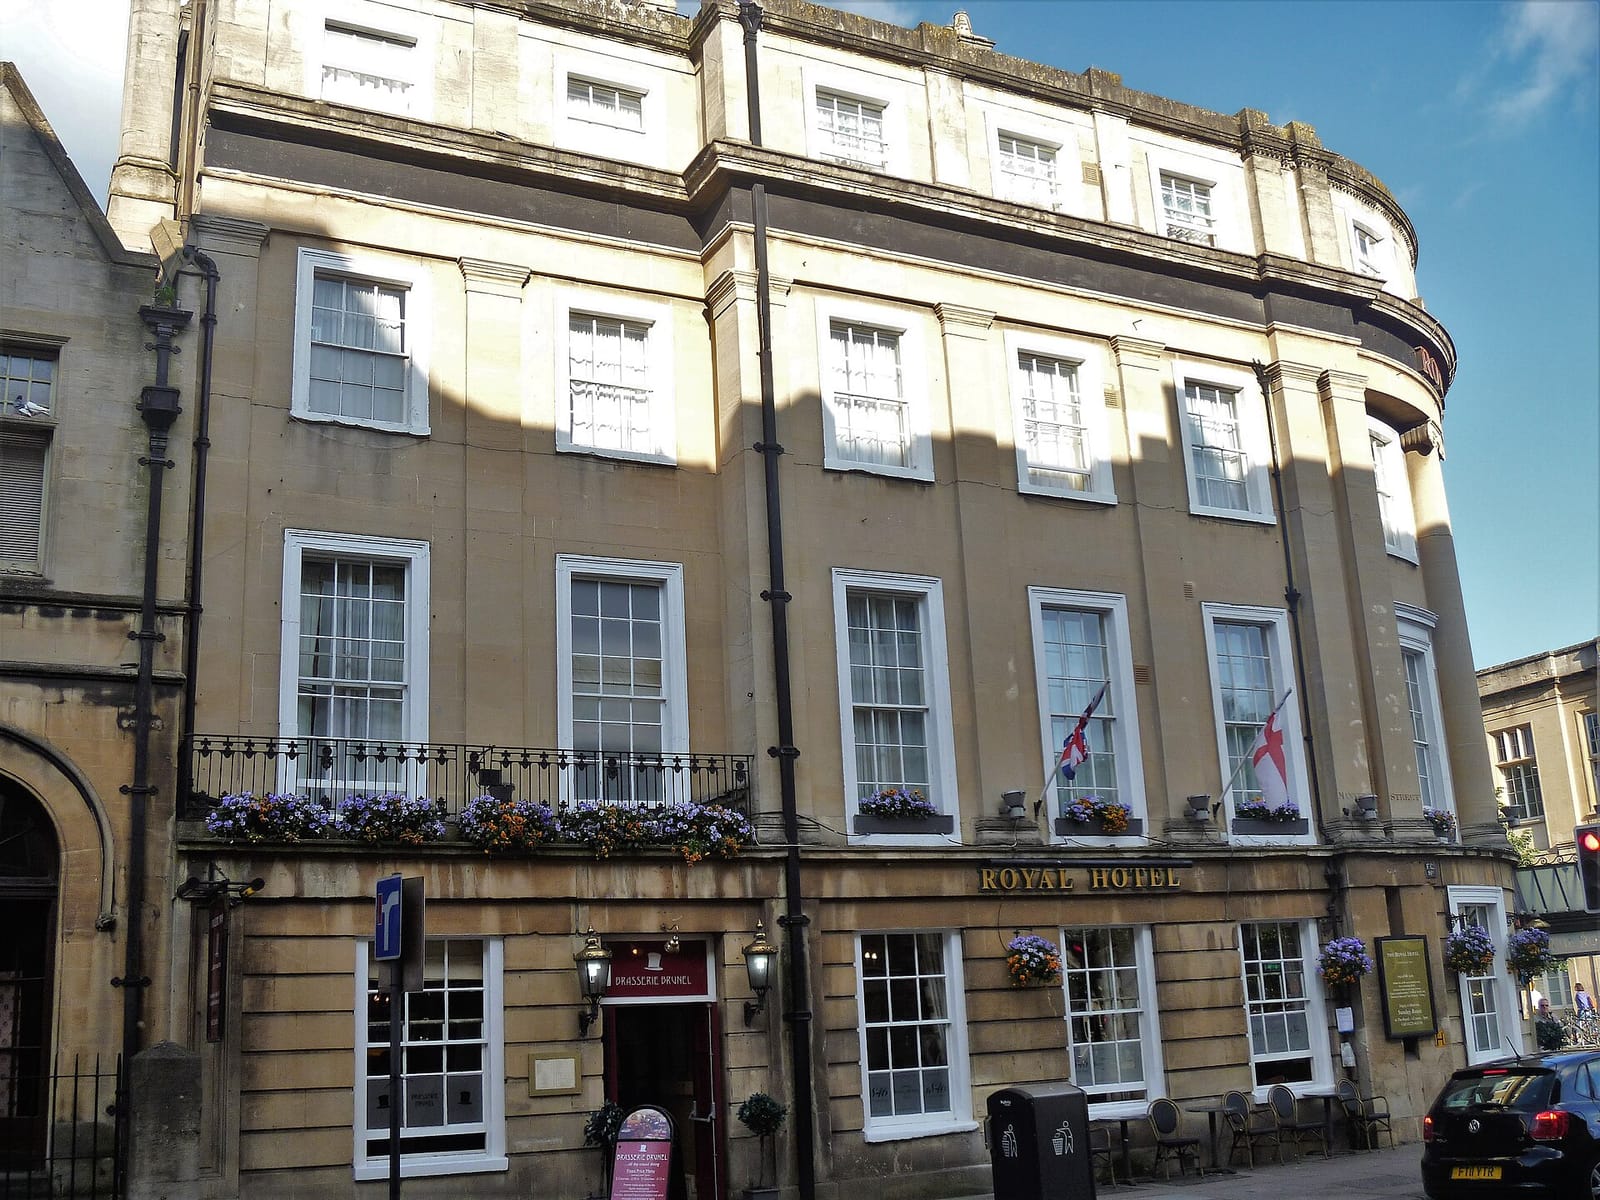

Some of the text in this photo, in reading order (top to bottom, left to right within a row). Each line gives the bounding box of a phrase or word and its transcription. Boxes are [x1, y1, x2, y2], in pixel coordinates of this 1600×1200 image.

[981, 867, 1181, 890] ROYAL HOTEL
[615, 975, 692, 986] BRASSERIE BRUNEL
[616, 1153, 668, 1161] BRASSERIE BRUNEL
